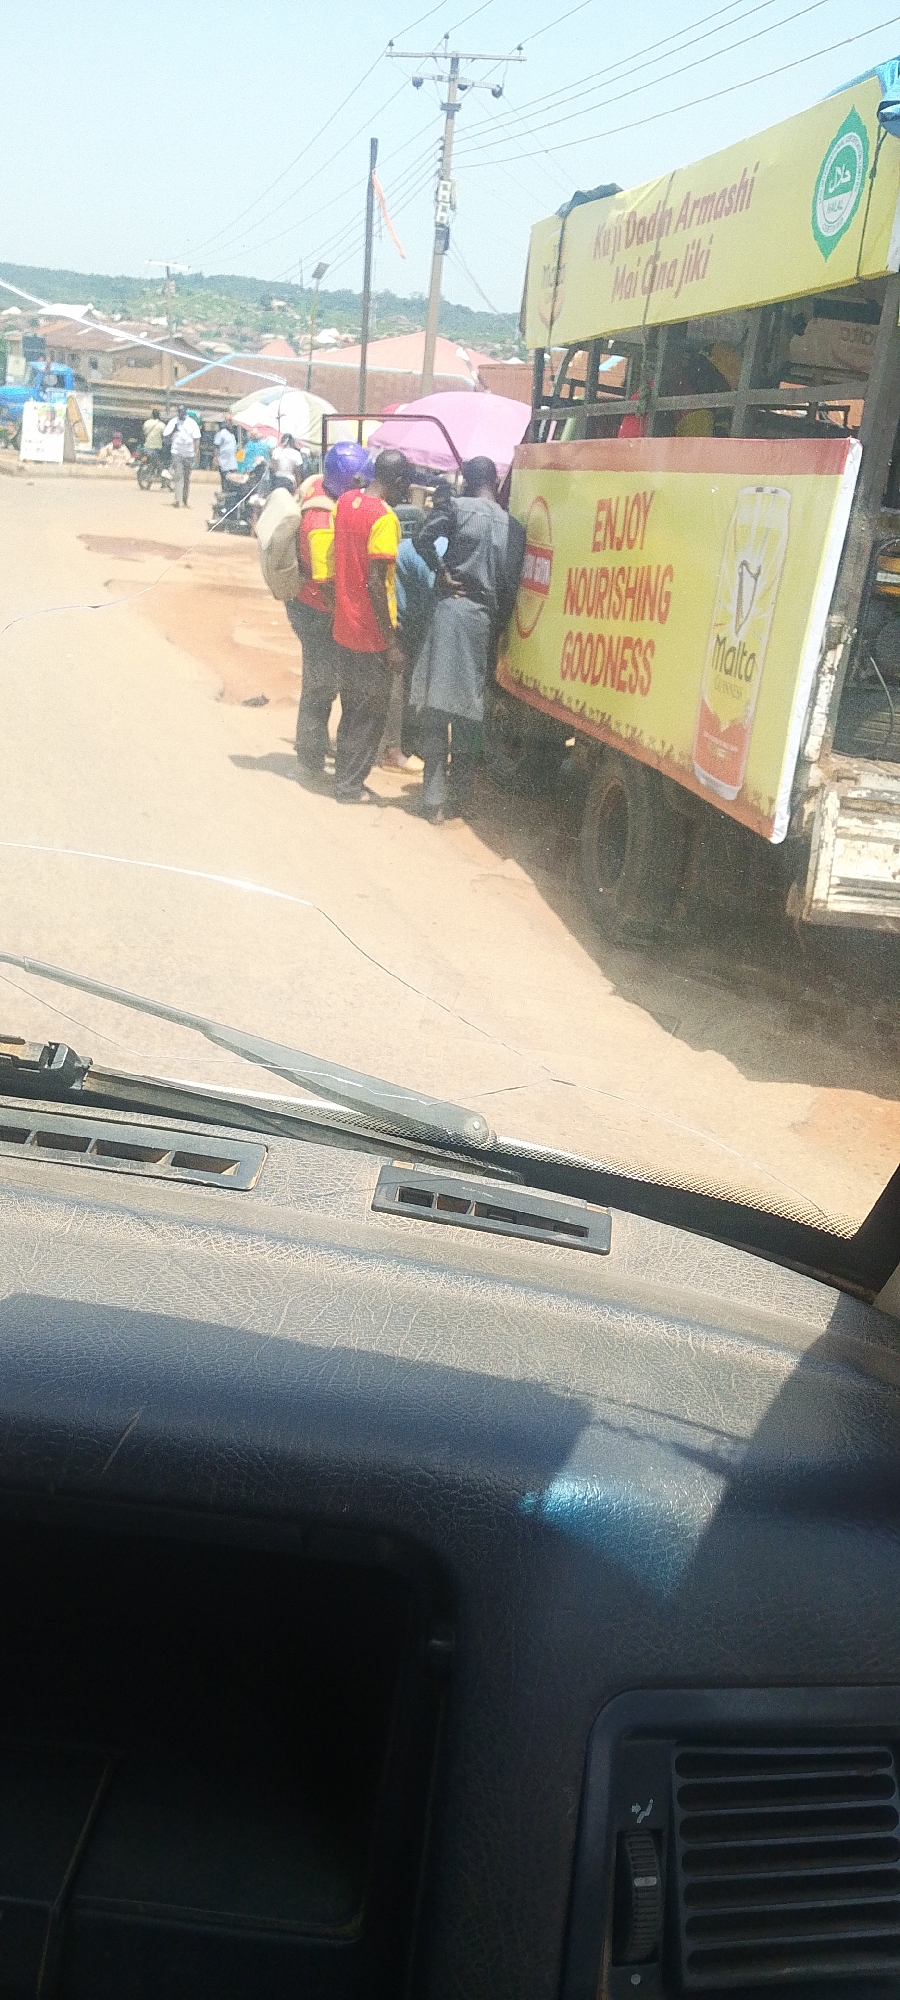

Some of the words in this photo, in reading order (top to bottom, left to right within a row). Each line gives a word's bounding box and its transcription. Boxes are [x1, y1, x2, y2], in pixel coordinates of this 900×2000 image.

[674, 161, 761, 233] Armashi
[611, 257, 641, 303] Mai
[674, 233, 714, 299] Jiki
[591, 490, 655, 553] ENJOY
[563, 564, 674, 625] NOURISHING
[560, 630, 656, 697] GOODNESS
[712, 633, 756, 682] Malta
